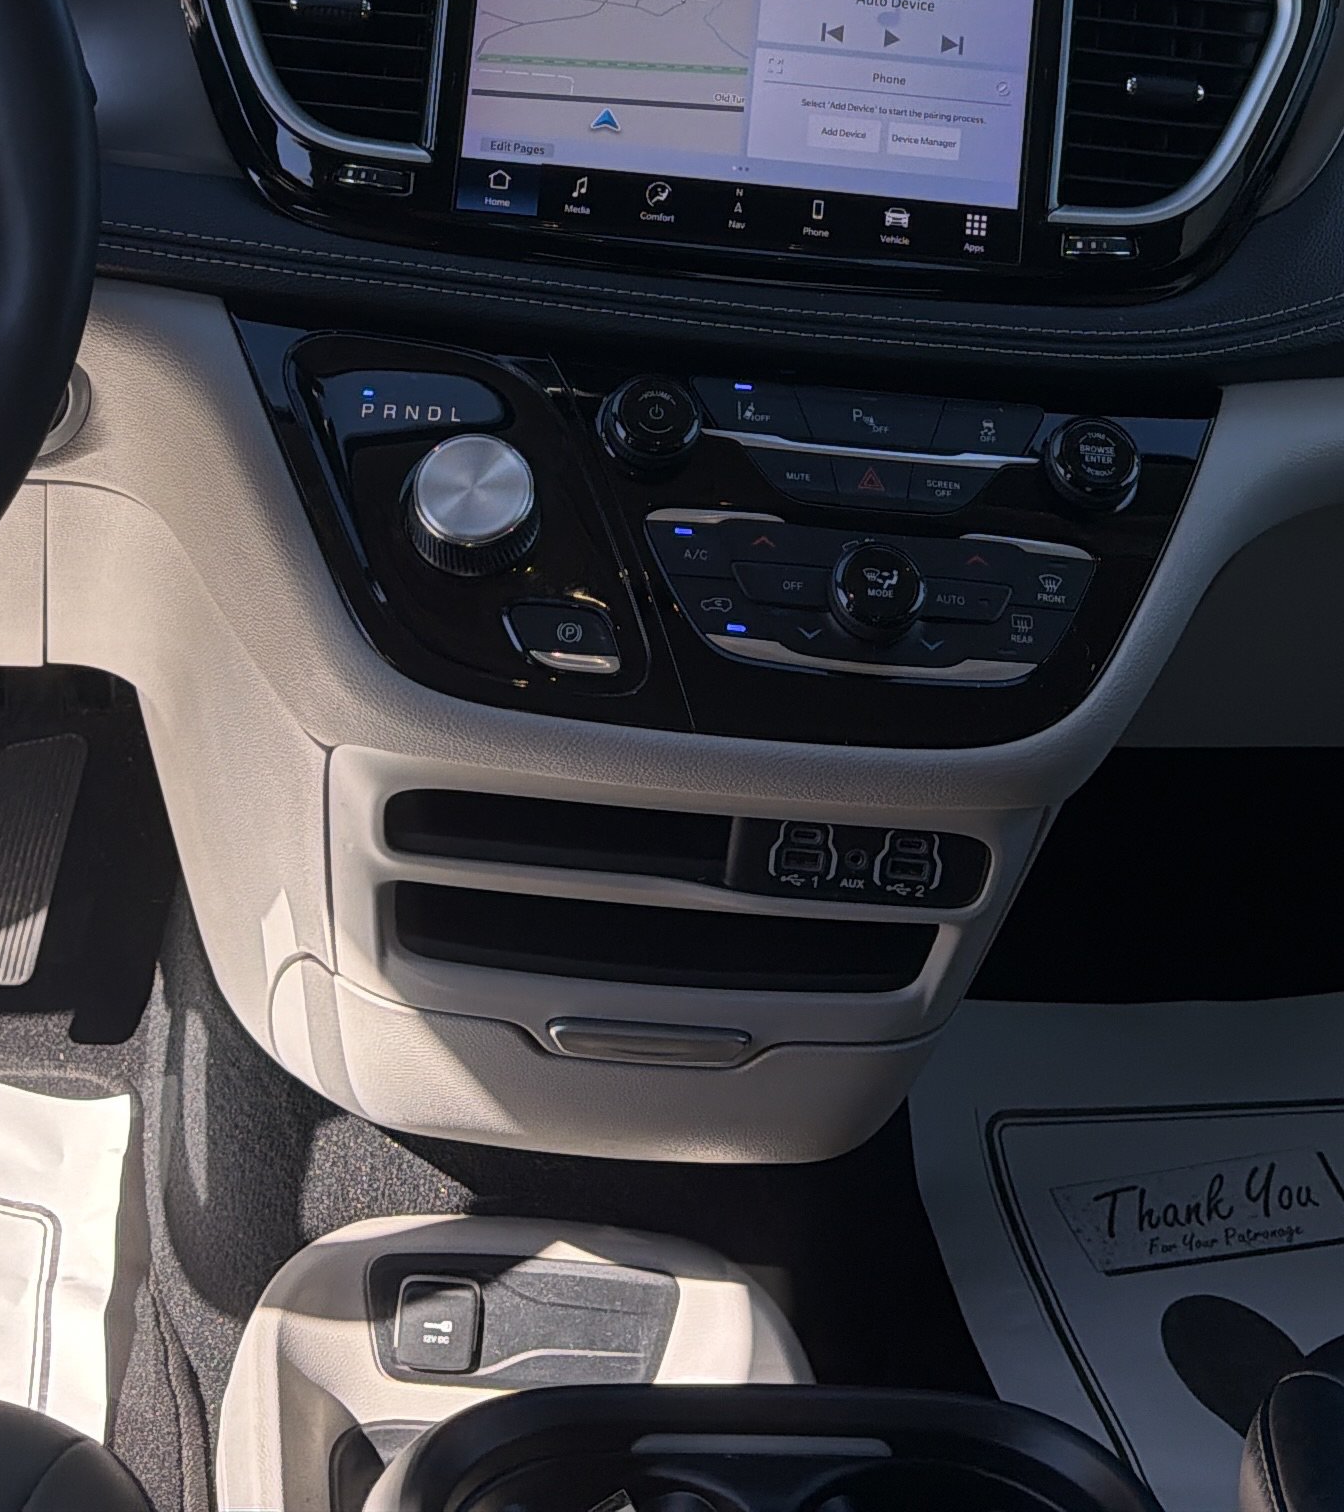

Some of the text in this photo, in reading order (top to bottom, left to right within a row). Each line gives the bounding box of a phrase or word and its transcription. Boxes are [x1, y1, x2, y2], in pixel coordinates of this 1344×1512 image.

[872, 72, 907, 86] Phone
[713, 92, 730, 103] Old
[800, 98, 827, 110] Select
[878, 105, 888, 115] to
[888, 107, 908, 117] start
[908, 109, 923, 119] the
[923, 110, 952, 123] pairing
[952, 114, 988, 125] process.
[821, 127, 867, 140] Add Device
[490, 140, 545, 156] Edit Pages
[891, 134, 958, 150] Device Manager
[484, 196, 511, 208] Home
[563, 203, 591, 216] Media
[639, 210, 675, 223] Comfort
[728, 219, 746, 230] Nav
[802, 226, 830, 238] Phone
[879, 234, 911, 246] Vehicle
[963, 242, 985, 254] Apps
[641, 390, 673, 402] VOLUME
[872, 424, 890, 435] OFF
[979, 435, 997, 444] OFF
[1078, 444, 1116, 455] BROWSE
[1084, 454, 1114, 465] ENTER
[785, 471, 811, 483] MUTE
[1085, 467, 1114, 478] SCROLL
[926, 479, 961, 490] SCREEN
[934, 488, 952, 498] OFF
[683, 549, 708, 561] A/C
[782, 581, 804, 591] OFF
[867, 588, 895, 599] MODE
[935, 593, 966, 606] AUTO
[1036, 593, 1068, 605] FRONT
[1010, 634, 1033, 645] REAR
[811, 875, 819, 888] 1
[839, 878, 865, 889] AUX
[914, 885, 925, 898] 2
[1092, 1162, 1320, 1238] Thank You
[1148, 1224, 1304, 1255] For Your Patronage
